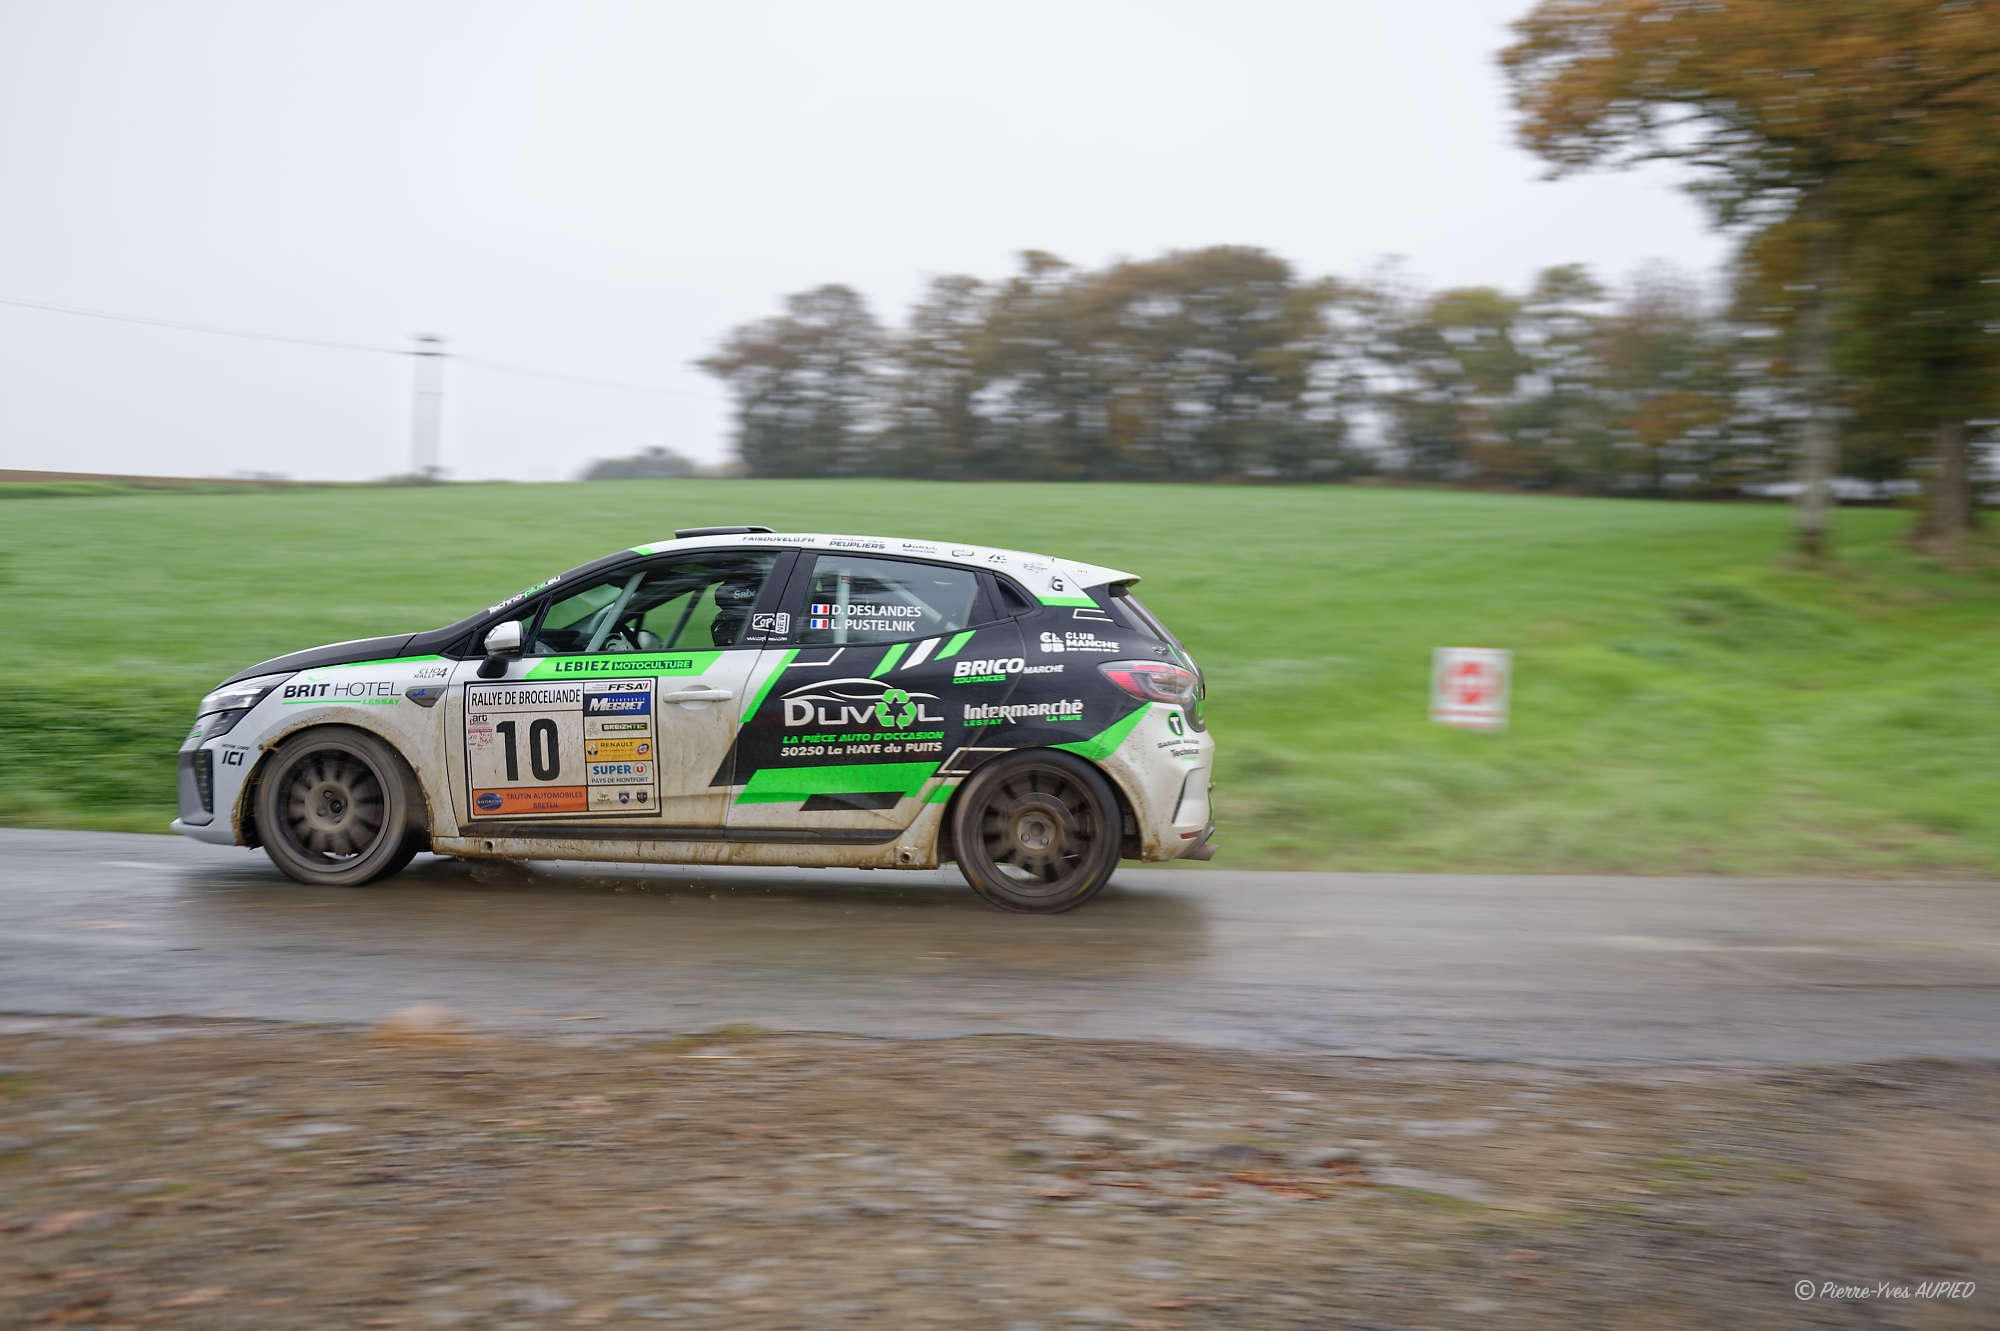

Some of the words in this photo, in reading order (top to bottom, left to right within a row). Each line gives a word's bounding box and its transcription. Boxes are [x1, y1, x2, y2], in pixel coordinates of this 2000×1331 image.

[829, 540, 885, 549] PEUPLIERS
[488, 575, 560, 614] Techno-plus.eu
[831, 605, 844, 616] D.
[848, 605, 921, 617] DESLANDES
[831, 620, 841, 630] L.
[845, 619, 916, 632] PUSTELNIK
[1065, 632, 1095, 640] CLUB
[1065, 639, 1119, 649] MANCHE
[555, 661, 610, 672] LEBIEZ
[613, 660, 691, 670] MOTOCULTURE
[953, 657, 1025, 677] BRICO
[953, 674, 1006, 684] COUTANCES
[283, 683, 330, 698] BRIT
[333, 682, 401, 697] HOTEL
[608, 683, 645, 691] FFSA
[471, 691, 503, 706] RALLYE
[505, 691, 517, 705] DE
[519, 689, 581, 704] BROCELIANDE
[963, 700, 1084, 724] Intermarché
[782, 735, 799, 744] LA
[801, 733, 837, 743] PIÈCE
[838, 732, 872, 742] AUTO
[873, 731, 945, 741] D'OCCASION
[496, 718, 560, 782] 10
[780, 746, 824, 757] 50250
[827, 745, 842, 755] La
[846, 744, 881, 754] HAYE
[884, 743, 902, 753] du
[905, 742, 943, 752] PUITS
[593, 765, 632, 775] SUPER
[533, 791, 583, 800] AUTOMOBILES
